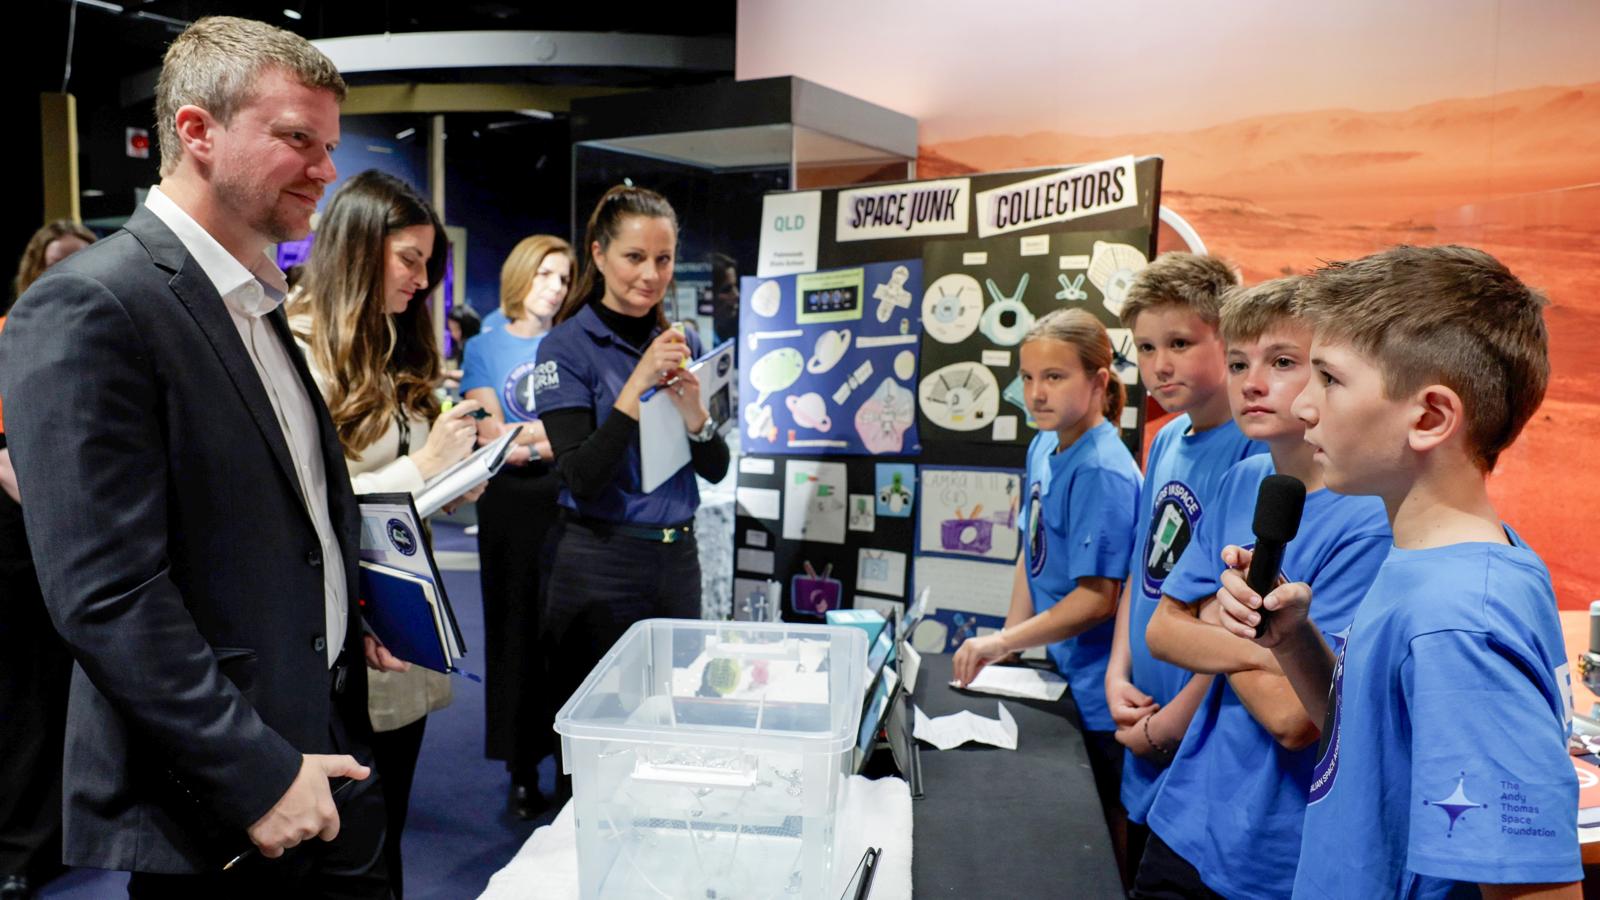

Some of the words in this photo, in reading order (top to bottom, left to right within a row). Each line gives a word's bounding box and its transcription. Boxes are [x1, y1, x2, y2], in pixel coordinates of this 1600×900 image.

[996, 166, 1126, 229] COLLECTORS
[852, 193, 907, 229] SPACE
[905, 188, 961, 231] JUNK
[773, 214, 805, 232] QLD
[1500, 780, 1520, 790] The
[1500, 792, 1527, 804] Andy
[1501, 803, 1540, 814] Thomas
[1501, 814, 1532, 824] Space
[1501, 825, 1556, 837] Foundation
